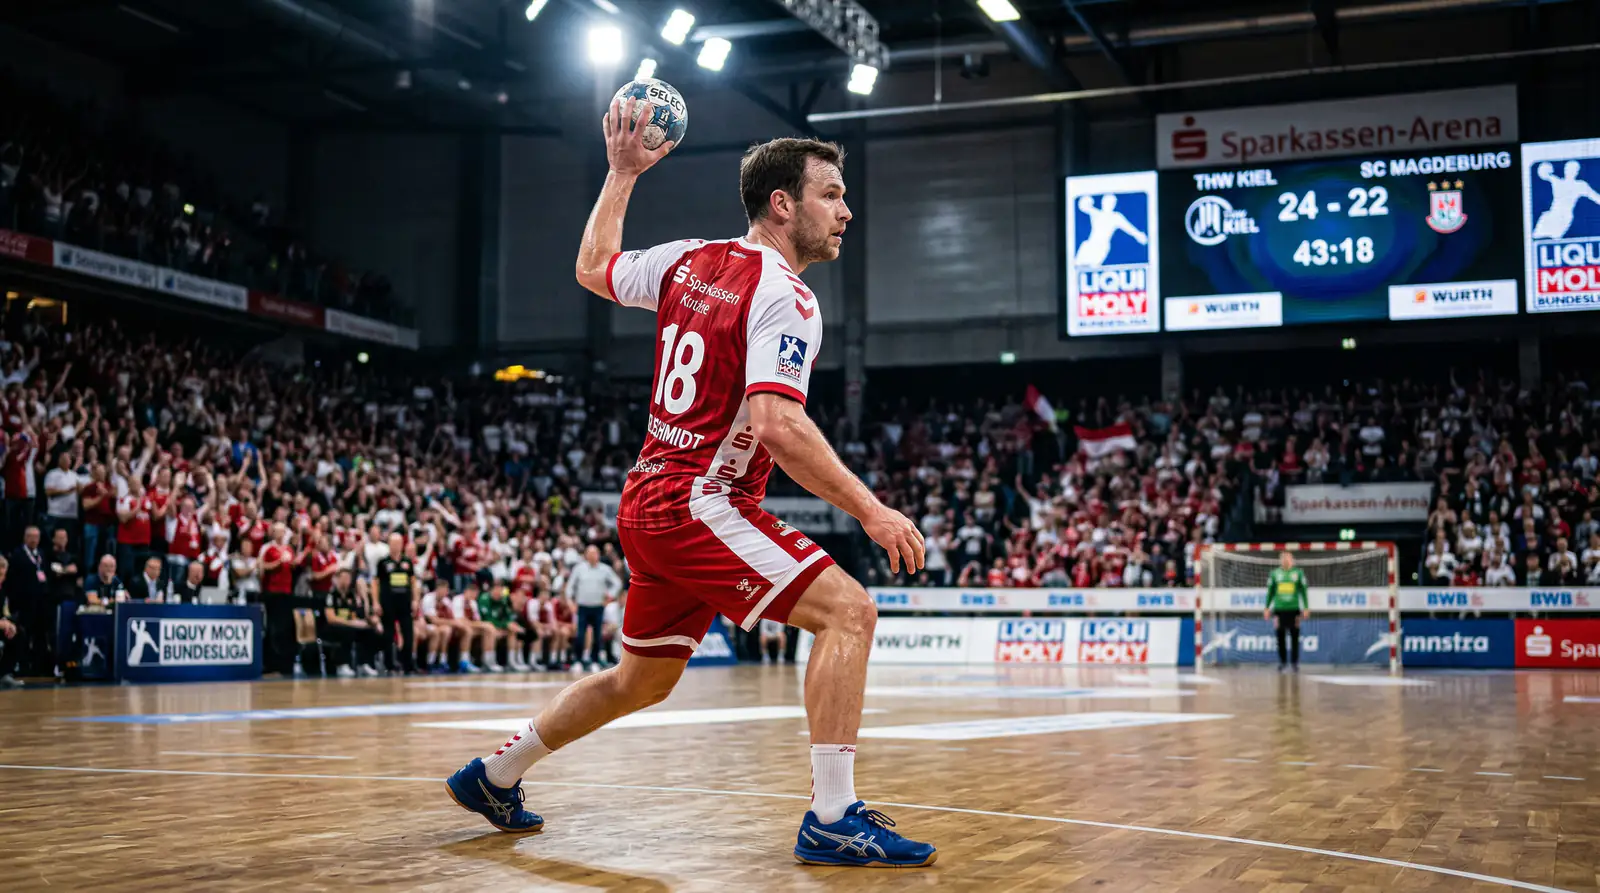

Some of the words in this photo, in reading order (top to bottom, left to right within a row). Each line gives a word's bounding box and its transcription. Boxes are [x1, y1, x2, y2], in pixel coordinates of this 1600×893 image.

[650, 87, 685, 115] SELECT
[1221, 115, 1501, 163] Sparkassen-Arena
[1360, 160, 1387, 178] SC
[1390, 151, 1512, 177] MAGDEBURG
[1193, 172, 1235, 190] THW
[1236, 169, 1278, 188] KIEL
[1278, 189, 1319, 222] 24
[1348, 186, 1389, 217] 22
[1223, 217, 1260, 234] KIEL
[1293, 236, 1375, 266] 43:18
[1080, 268, 1146, 293] LIQUI
[1541, 267, 1600, 293] MOL
[1080, 291, 1146, 316] MOLY
[654, 322, 705, 415] 18
[1291, 495, 1429, 513] Sparkassen-Arena
[1427, 591, 1468, 606] BWB
[1530, 591, 1572, 606] BWB
[164, 624, 206, 641] LIQUY
[211, 624, 249, 640] MOLY
[1000, 621, 1062, 641] LIQUI
[1083, 621, 1146, 641] LIQUI
[163, 644, 250, 660] BUNDESLIGA
[999, 642, 1063, 662] MOLY
[1081, 642, 1147, 662] MOLY
[1404, 632, 1489, 653] mnstra
